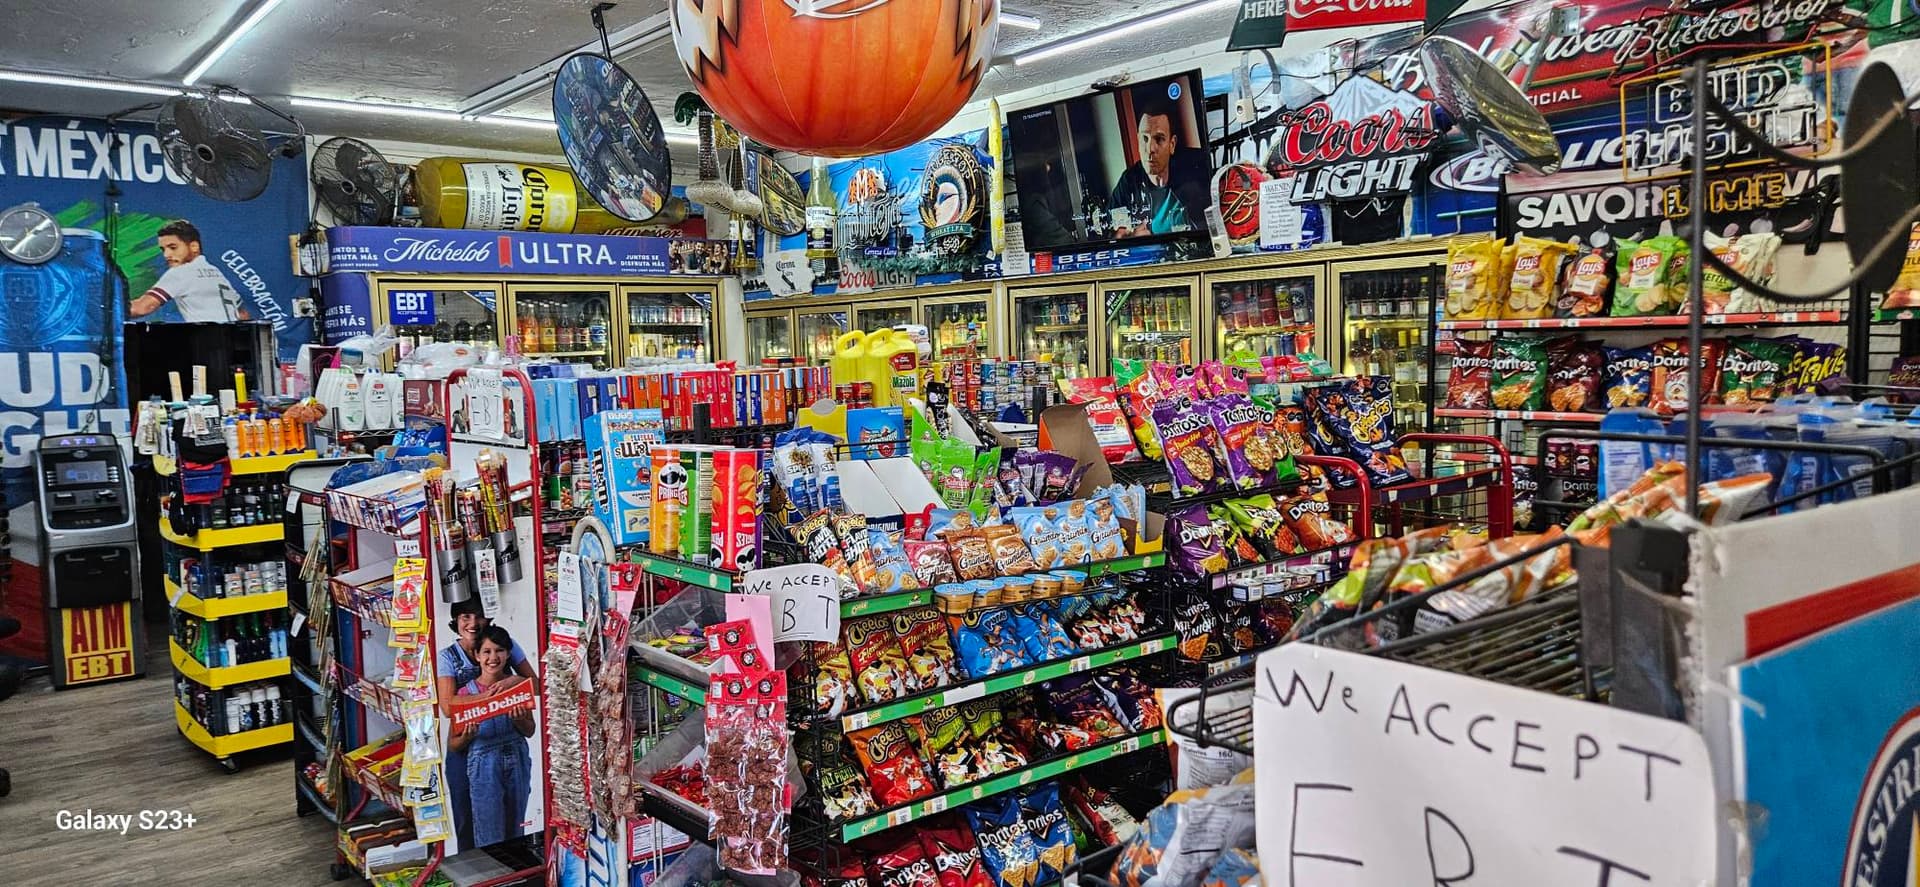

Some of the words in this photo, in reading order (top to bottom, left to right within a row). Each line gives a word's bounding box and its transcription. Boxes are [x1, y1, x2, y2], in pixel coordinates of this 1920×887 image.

[1244, 2, 1286, 20] HERE
[1280, 100, 1437, 167] Coors
[1291, 152, 1430, 202] LIGHT
[384, 237, 494, 263] Michelob
[519, 241, 616, 266] ULTRA
[1058, 248, 1131, 265] BEER
[839, 265, 877, 289] Coors
[221, 249, 287, 333] CELEBRACIÓN
[395, 292, 428, 311] EBT
[1722, 354, 1780, 372] Doritos
[1798, 352, 1846, 388] Takis
[892, 376, 916, 388] Mazola
[60, 437, 97, 446] ATM
[1289, 500, 1330, 520] Doritos
[745, 580, 772, 595] We
[71, 602, 127, 655] ATM
[849, 616, 890, 647] Cheetos
[893, 609, 940, 635] Cheetos
[72, 652, 127, 681] EBT
[454, 705, 488, 725] Little
[488, 691, 532, 714] Debbie
[1265, 667, 1360, 714] We
[1384, 684, 1682, 803] ACCEPT
